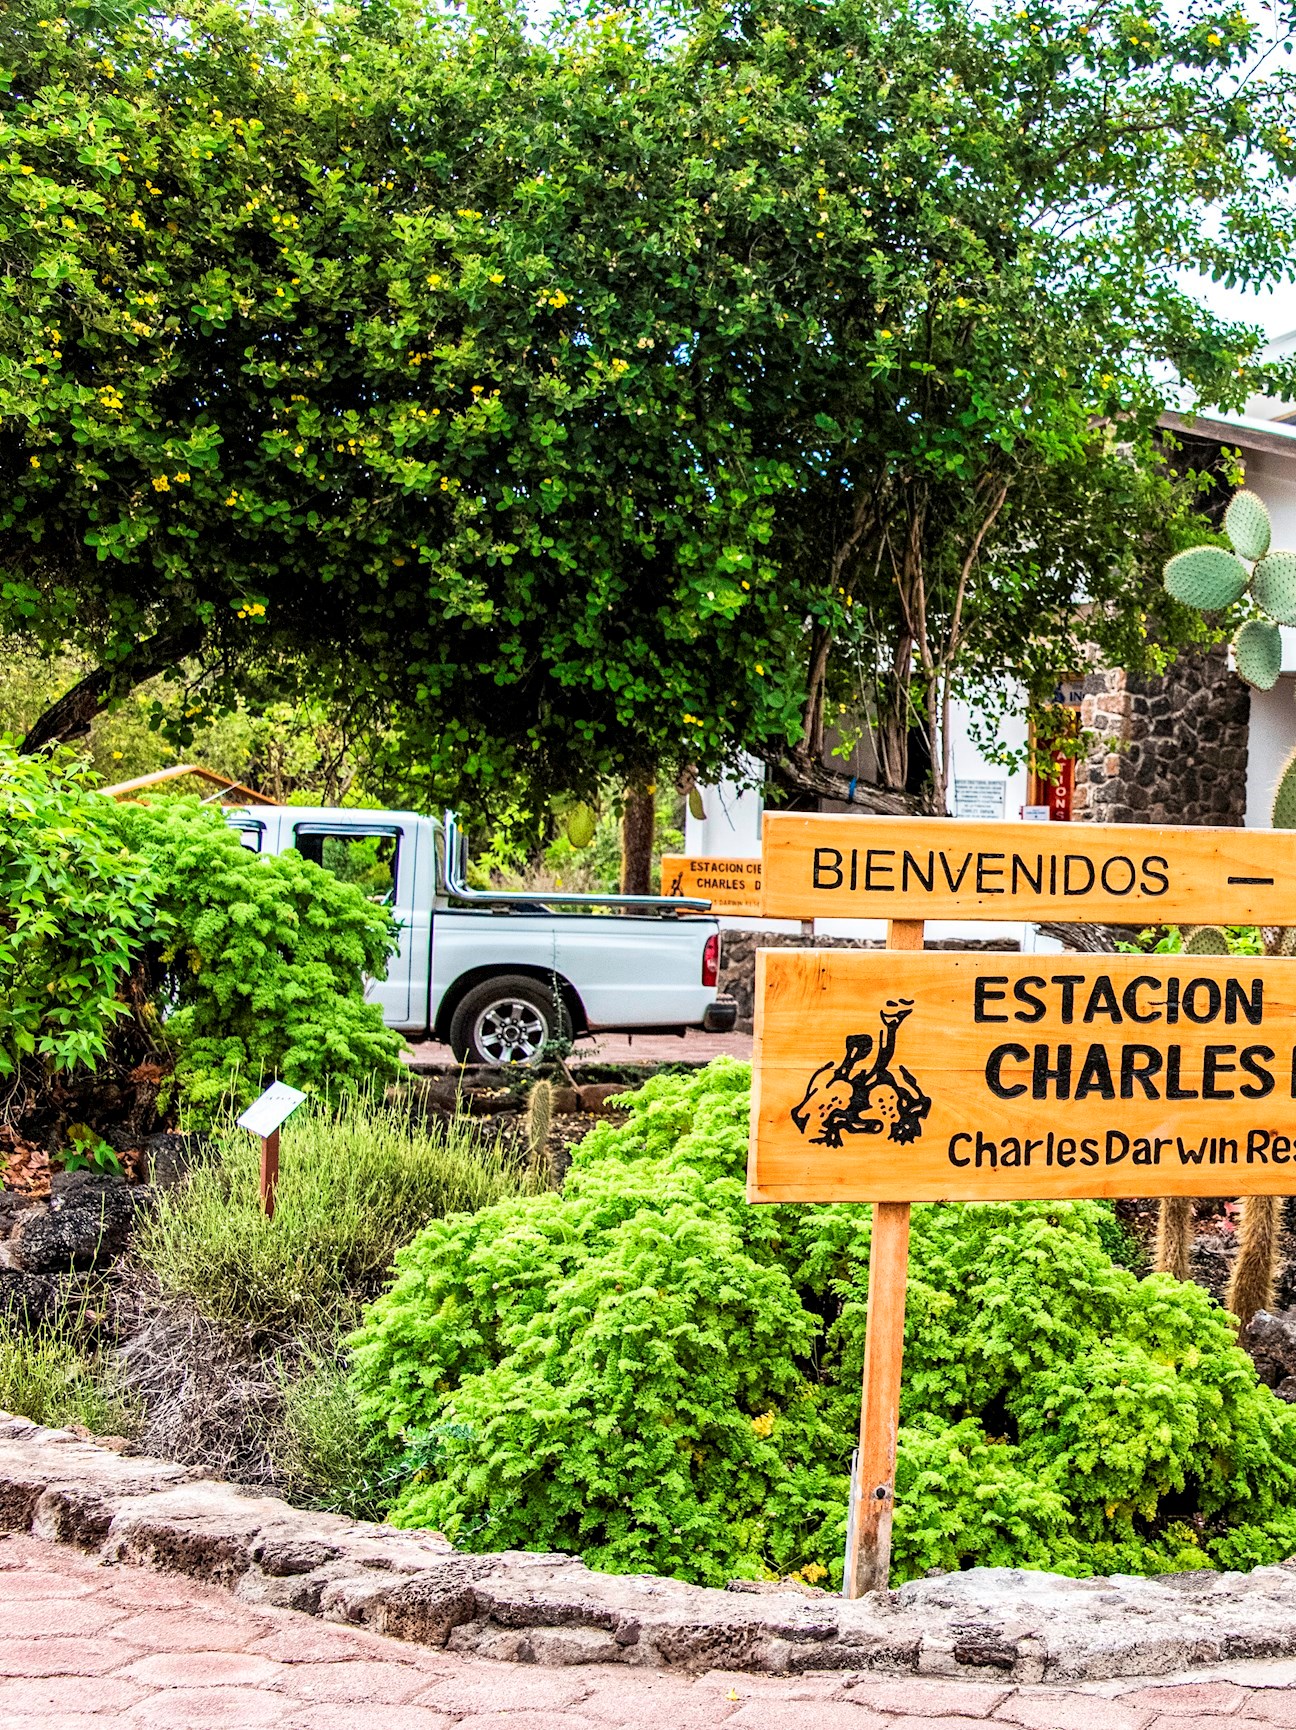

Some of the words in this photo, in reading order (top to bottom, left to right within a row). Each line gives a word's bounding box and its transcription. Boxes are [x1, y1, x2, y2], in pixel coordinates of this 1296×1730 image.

[691, 861, 743, 873] ESTACION
[697, 878, 745, 889] CHARLES
[812, 847, 1169, 896] BIENVENIDOS
[973, 975, 1264, 1026] ESTACION
[984, 1042, 1276, 1101] CHARLES
[948, 1130, 1100, 1168] Charles
[1105, 1130, 1238, 1166] Darwin
